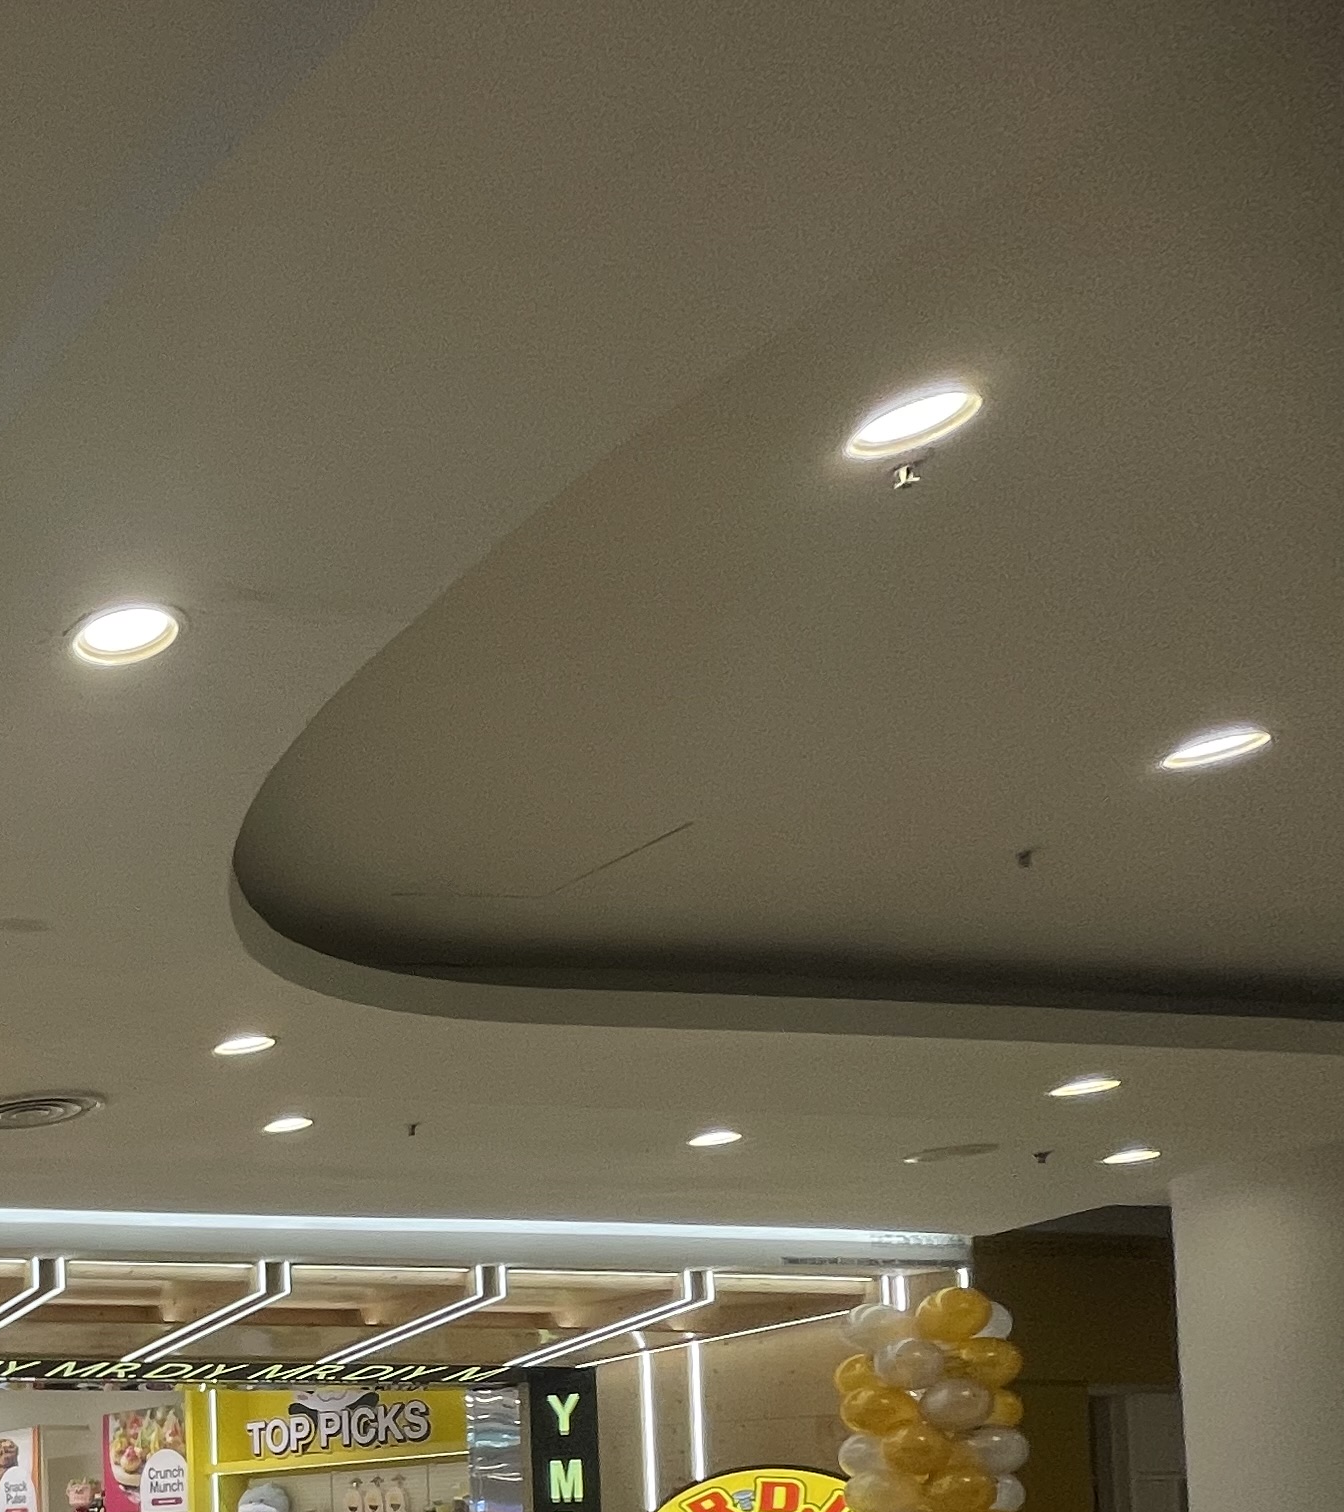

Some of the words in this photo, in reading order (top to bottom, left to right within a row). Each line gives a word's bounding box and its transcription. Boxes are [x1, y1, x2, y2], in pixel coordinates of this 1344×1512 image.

[44, 1360, 251, 1380] MR.DIY
[246, 1415, 312, 1456] TOP
[316, 1400, 432, 1449] PICKS
[147, 1465, 185, 1481] Crunch
[149, 1479, 185, 1494] Munch
